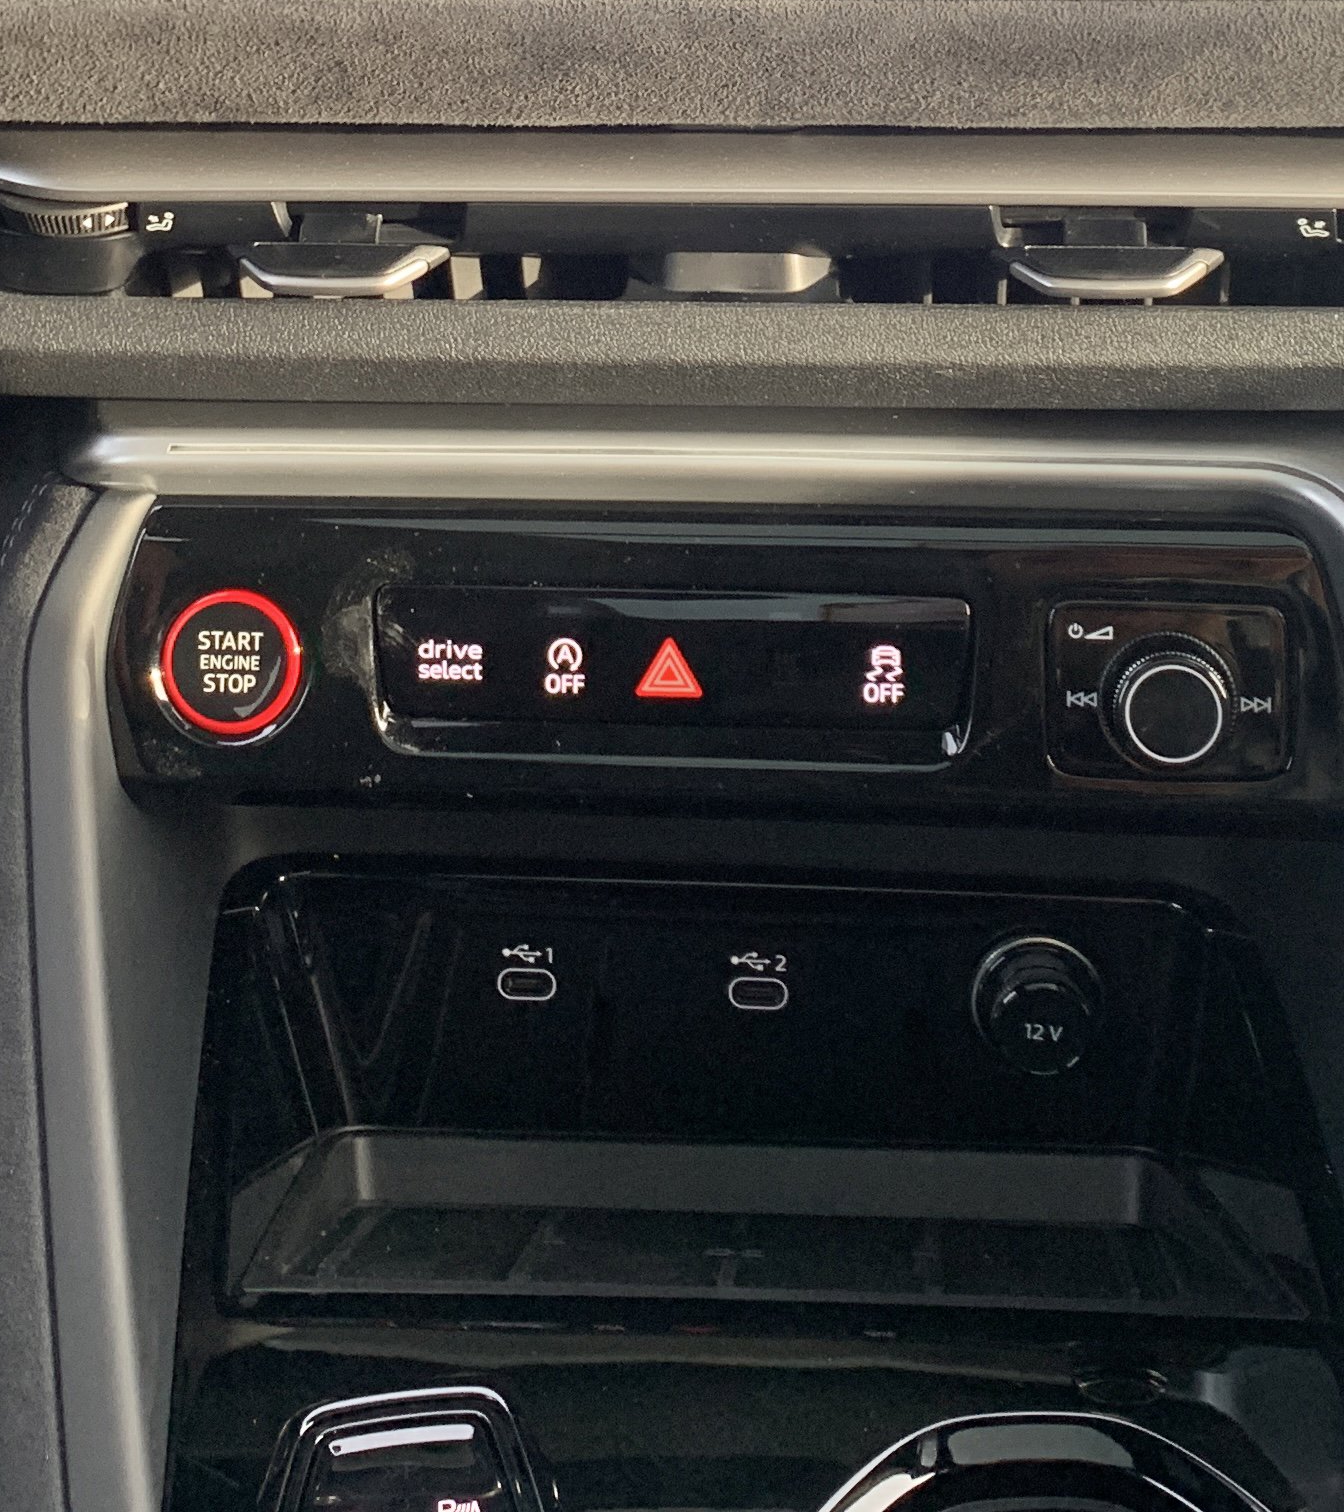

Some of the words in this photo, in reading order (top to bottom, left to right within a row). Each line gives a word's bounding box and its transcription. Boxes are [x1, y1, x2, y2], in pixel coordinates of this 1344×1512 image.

[197, 631, 264, 652] START
[418, 639, 483, 660] drive
[199, 655, 261, 671] ENGINE
[418, 661, 483, 681] select
[202, 674, 257, 694] STOP
[544, 674, 586, 695] OFF
[862, 683, 905, 704] OFF
[545, 947, 554, 964] 1
[775, 954, 787, 972] 2
[1024, 1023, 1044, 1041] 12
[1049, 1025, 1064, 1042] V
